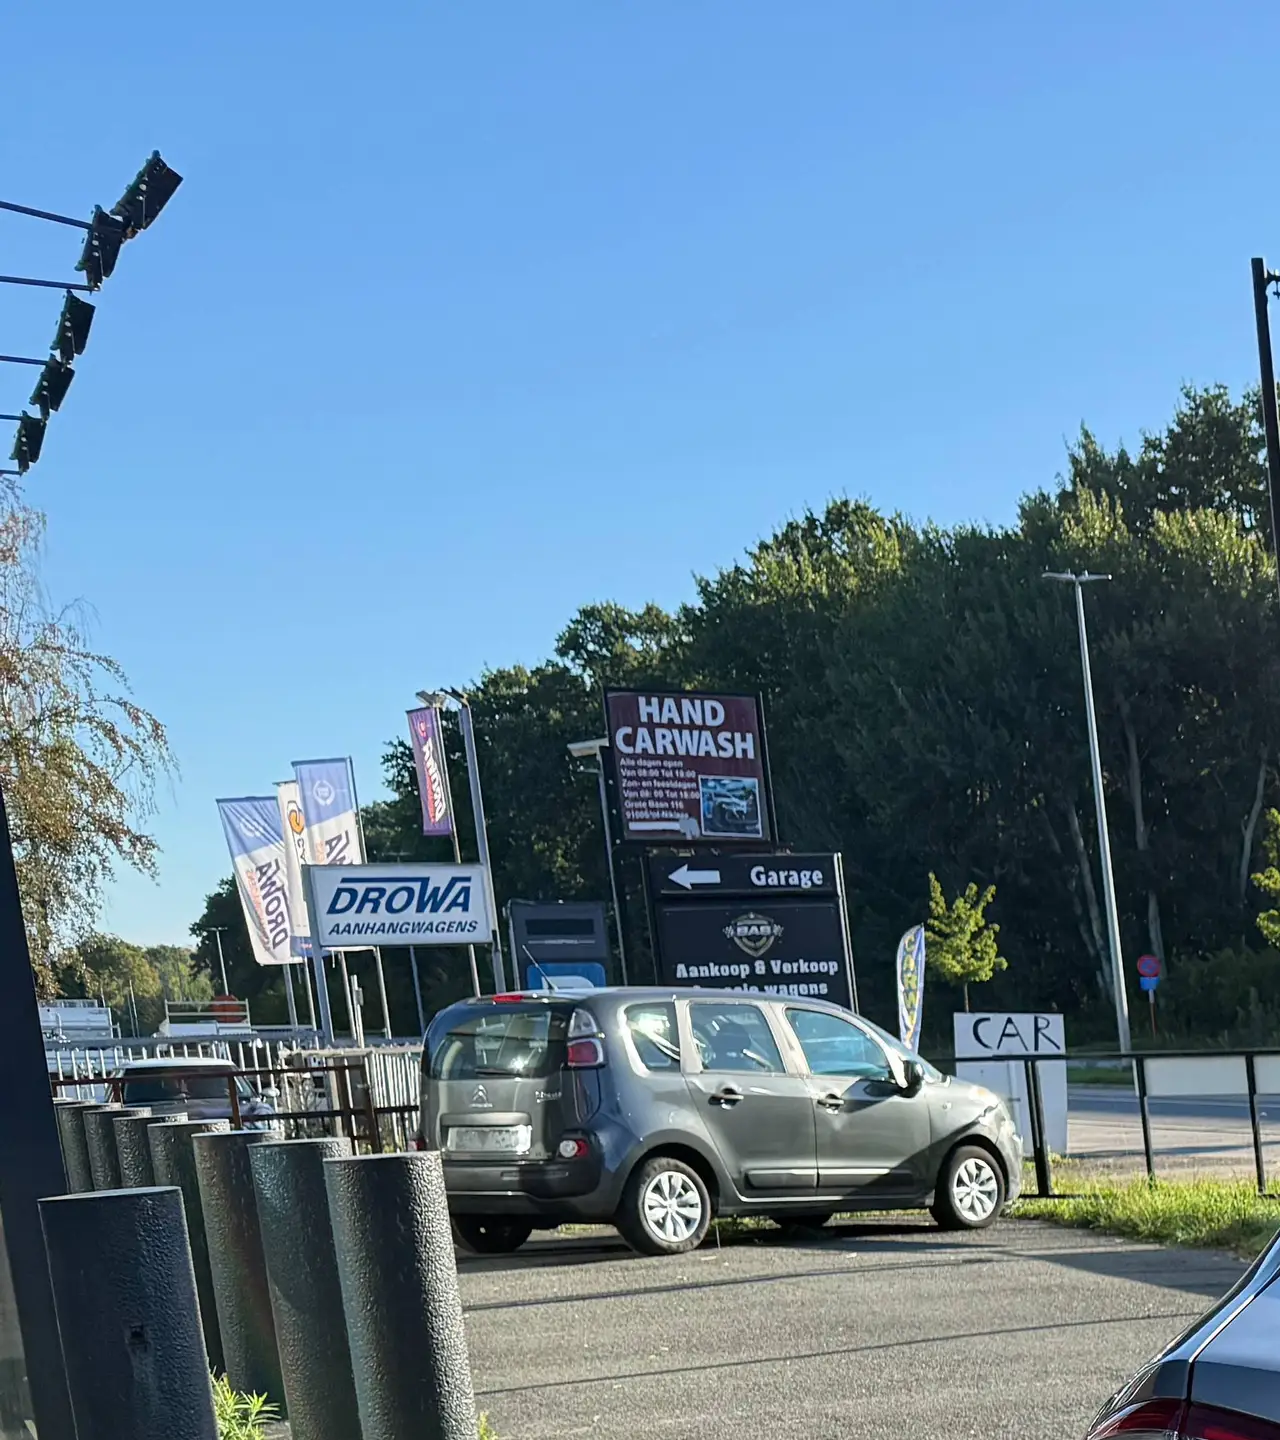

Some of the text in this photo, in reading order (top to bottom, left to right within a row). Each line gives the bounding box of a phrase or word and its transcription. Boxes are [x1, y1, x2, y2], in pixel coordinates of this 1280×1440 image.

[638, 696, 725, 727] HAND
[615, 726, 755, 759] CARWASH
[750, 866, 823, 888] Garage
[326, 877, 472, 915] DROWA
[328, 920, 478, 936] AANHANGWAGENS
[676, 959, 838, 979] Aankoop & Verkoop
[973, 1016, 1061, 1052] CAR
